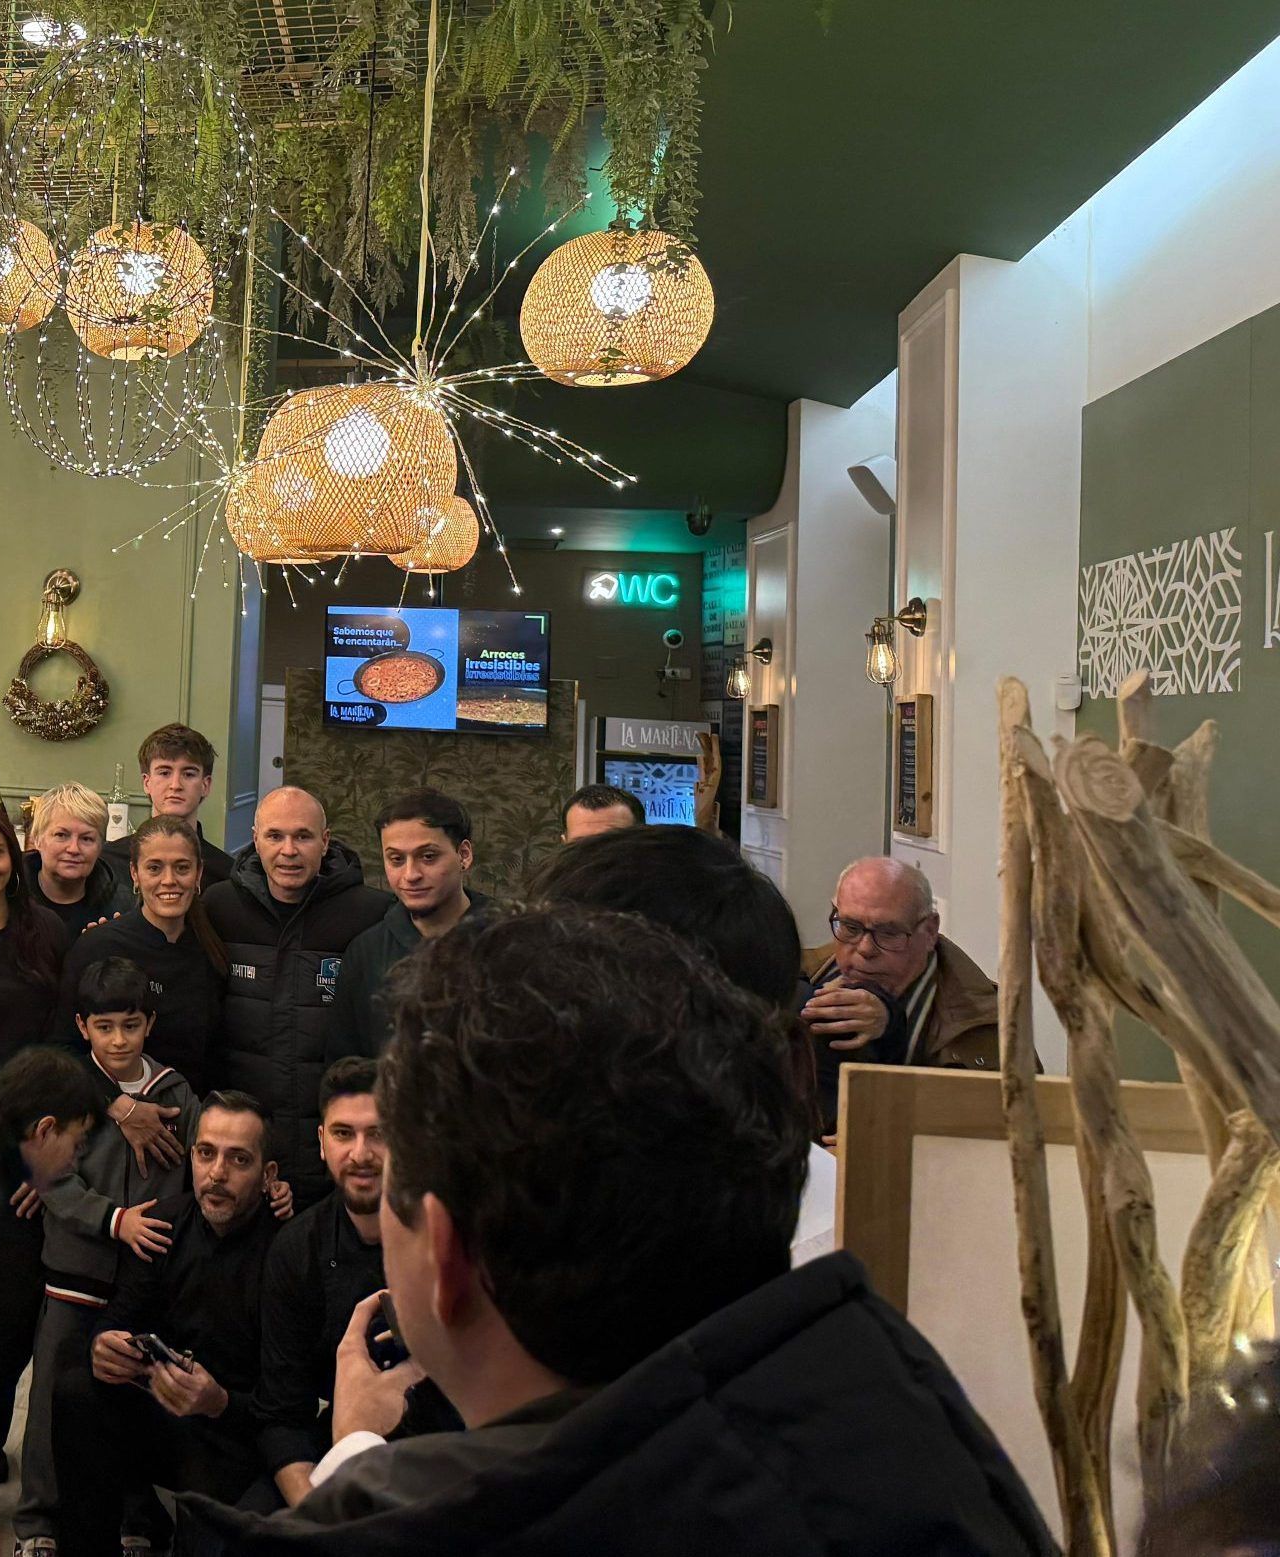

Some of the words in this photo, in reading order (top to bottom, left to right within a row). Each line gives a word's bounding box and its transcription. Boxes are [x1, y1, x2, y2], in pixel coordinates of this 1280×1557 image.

[619, 573, 677, 604] WC
[333, 626, 374, 636] Sabemos
[376, 629, 394, 637] que
[333, 636, 344, 645] Te
[480, 649, 525, 660] Arroces
[621, 722, 636, 748] LA
[319, 977, 336, 985] INIE
